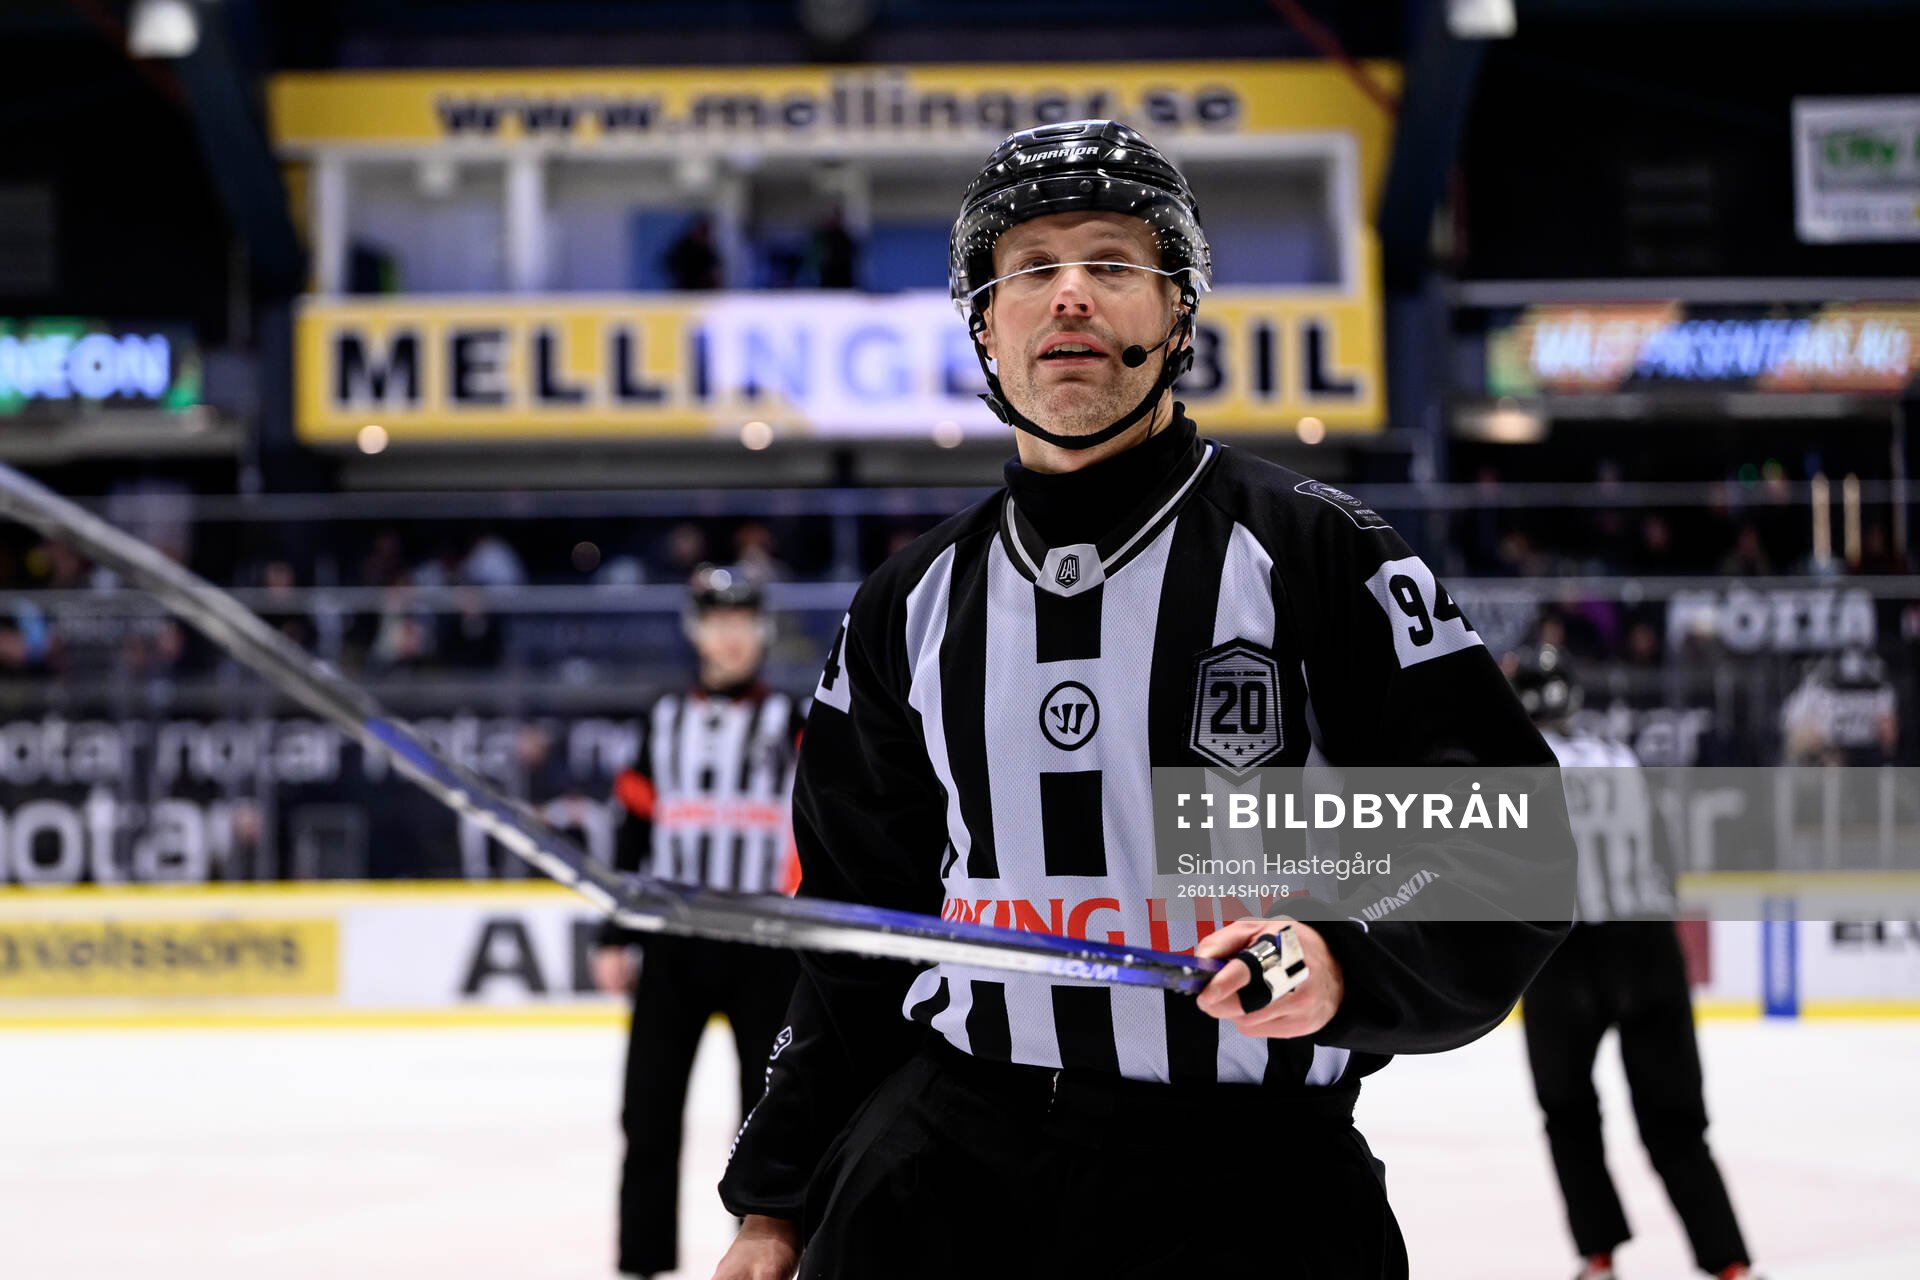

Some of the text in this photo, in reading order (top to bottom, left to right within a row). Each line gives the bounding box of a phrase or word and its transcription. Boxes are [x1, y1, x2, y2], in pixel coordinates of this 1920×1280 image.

[1019, 146, 1100, 166] WARRIOR
[334, 322, 990, 408] MELLINGE
[1389, 574, 1475, 647] 94
[1209, 680, 1267, 734] 20
